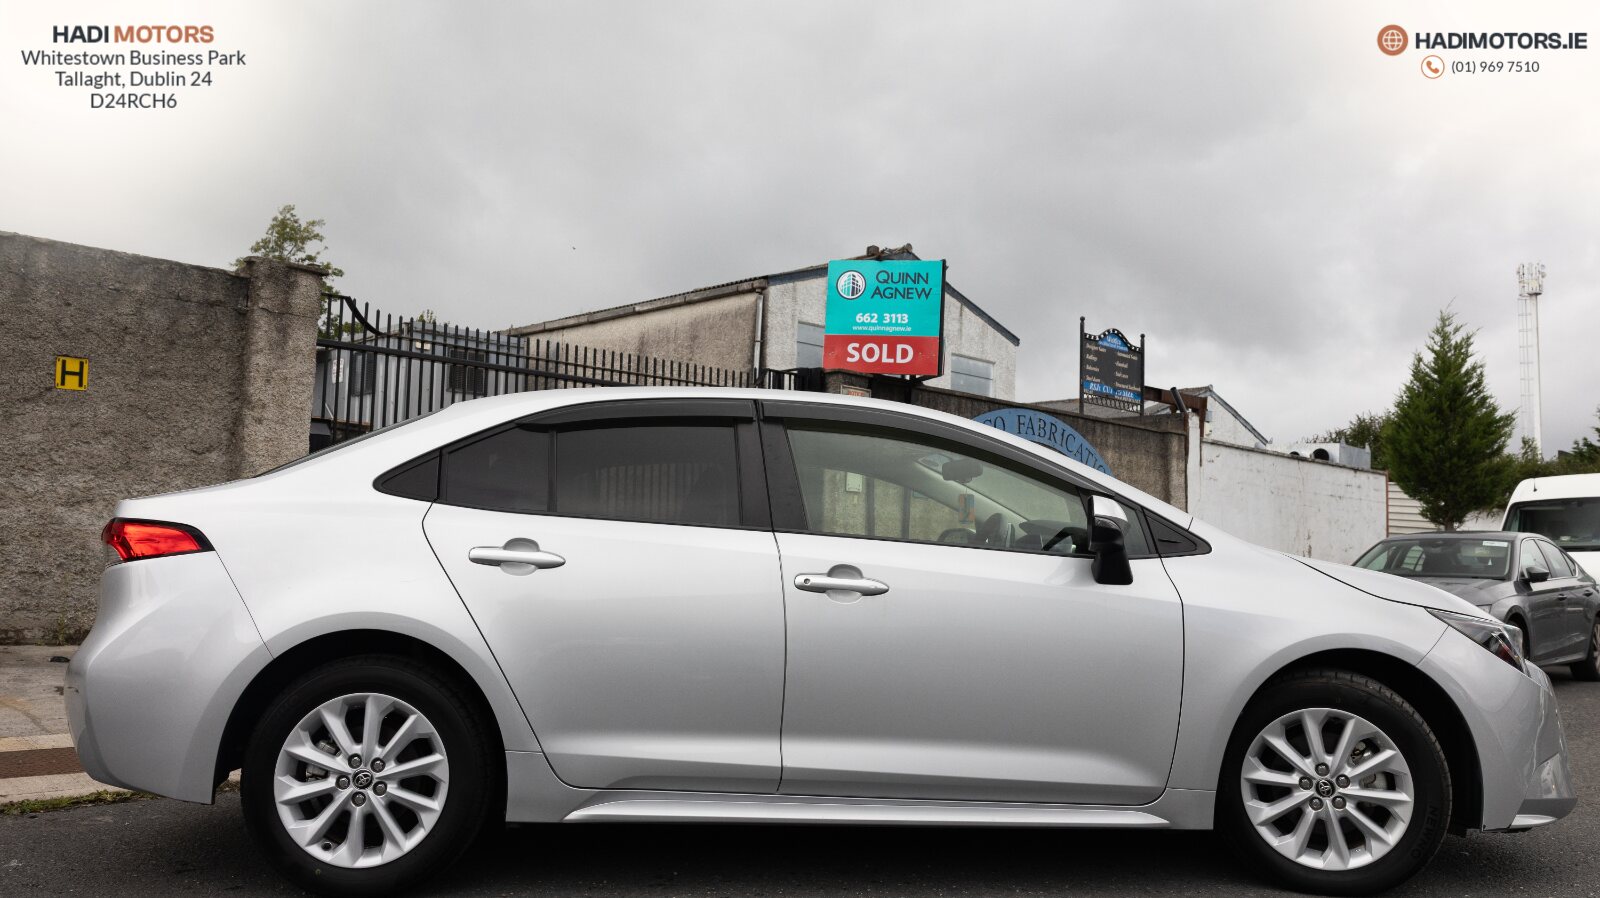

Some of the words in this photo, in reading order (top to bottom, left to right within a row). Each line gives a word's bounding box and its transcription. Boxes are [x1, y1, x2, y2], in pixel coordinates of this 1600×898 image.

[876, 270, 929, 285] QUINN
[870, 287, 932, 300] AGNEW
[855, 313, 878, 323] 662
[882, 313, 908, 324] 3113
[846, 342, 914, 364] SOLD
[60, 359, 84, 388] H
